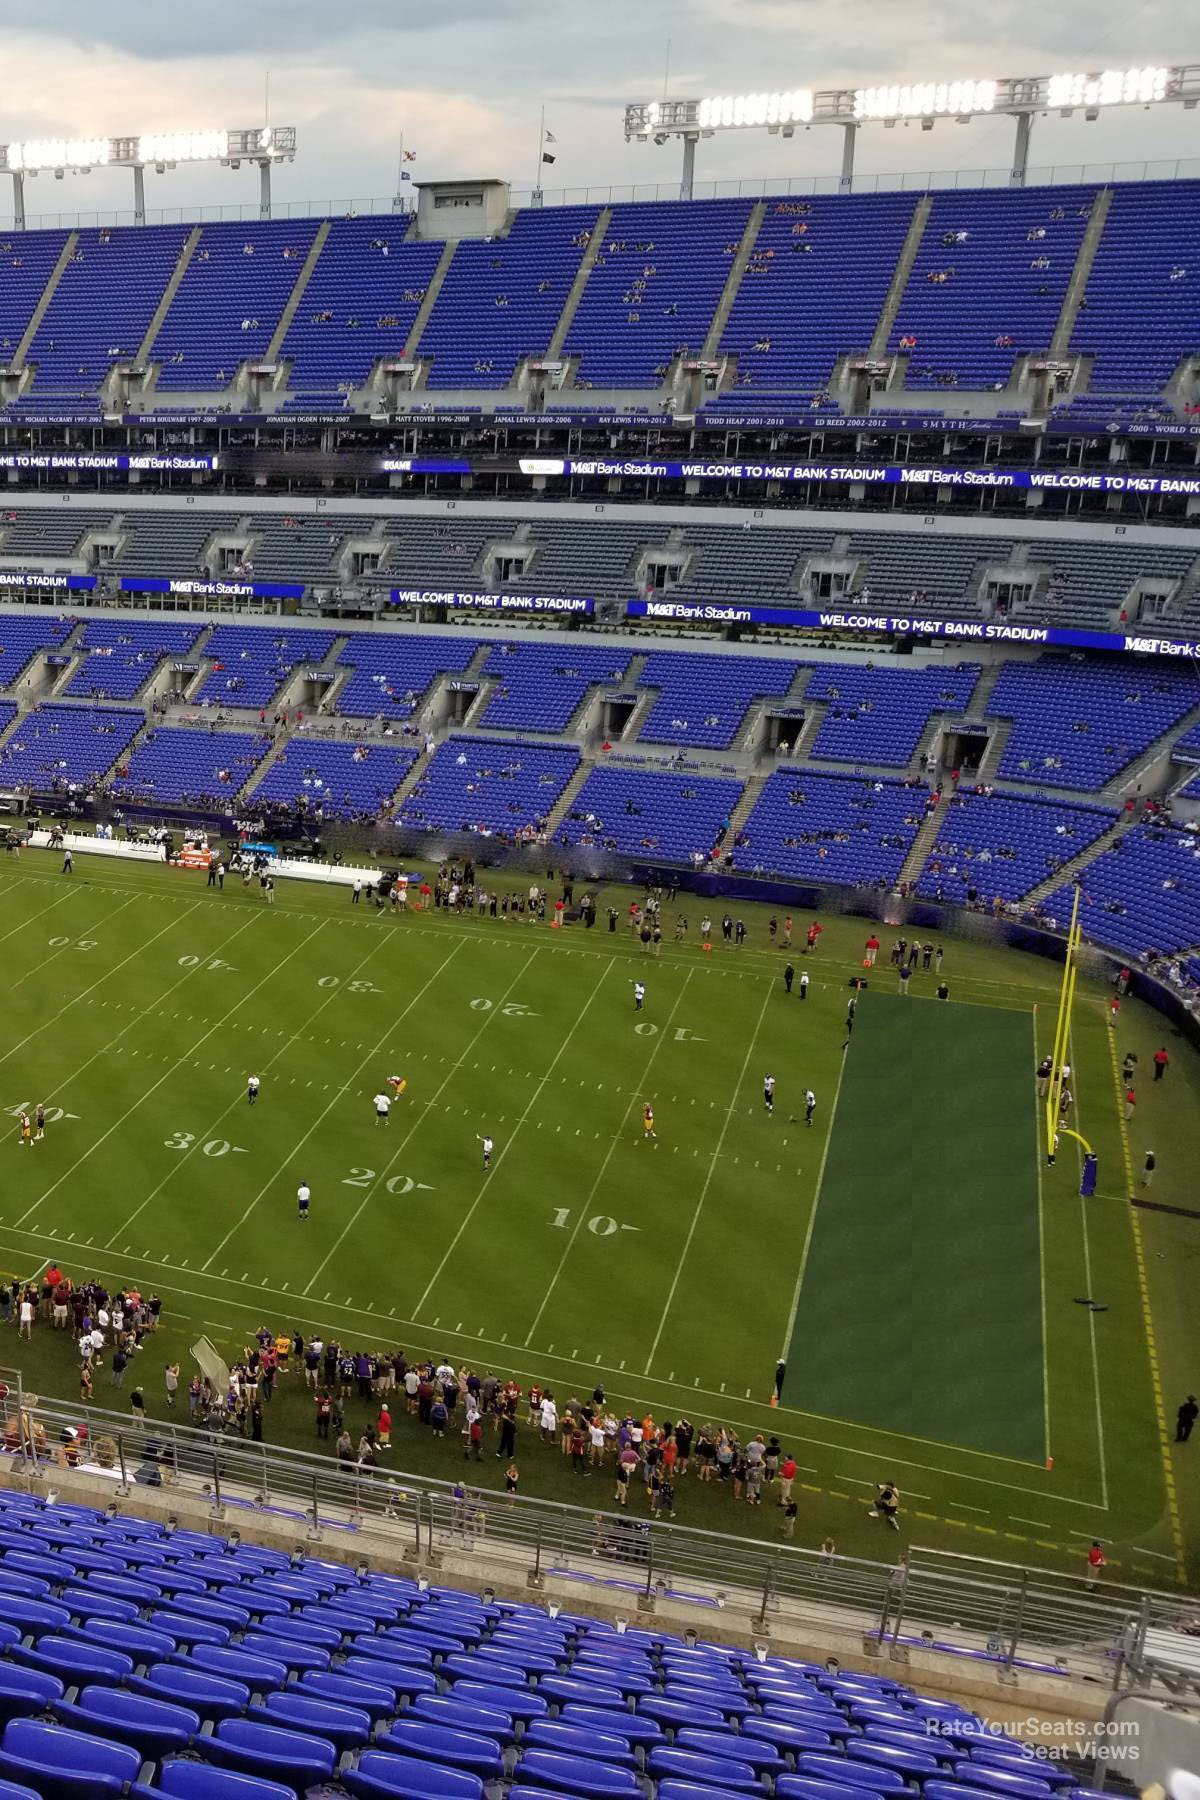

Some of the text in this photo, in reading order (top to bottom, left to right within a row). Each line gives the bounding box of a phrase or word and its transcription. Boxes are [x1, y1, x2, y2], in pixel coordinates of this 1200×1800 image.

[599, 416, 666, 424] RAY LEWIS 1996-2012
[746, 418, 785, 426] 2001-2010
[847, 419, 887, 427] 2002-2012
[1155, 425, 1186, 434] WORLD
[16, 457, 29, 466] TO
[30, 457, 50, 466] M&T
[51, 458, 76, 466] BANK
[76, 458, 118, 467] STADIUM
[129, 458, 207, 468] M&T Bank Stadium
[570, 462, 666, 474] M&T Bank Stadium
[681, 466, 886, 479] WELCOME TO M&T BANK STADIUM
[901, 470, 1013, 484] M&T Bank Stadium
[1030, 475, 1199, 492] WELCOME TO M&T BANK
[0, 575, 24, 584] BANK
[26, 576, 67, 586] STADIUM
[169, 581, 253, 594] M&T Bank Stadium
[399, 592, 586, 609] WELCOME TO M&T BANK STADIUM
[646, 603, 750, 619] M&T Bank Stadium
[820, 615, 1048, 639] WELCOME TO M&T BANK STADIUM
[1124, 638, 1160, 652] M&T
[1160, 641, 1193, 655] Bank
[48, 935, 98, 951] 50
[317, 976, 374, 993] 30
[469, 998, 529, 1016] 20
[634, 1022, 692, 1041] 10
[3, 1101, 66, 1123] 40
[164, 1131, 231, 1158] 30
[341, 1167, 414, 1194] 20
[547, 1207, 618, 1236] 10
